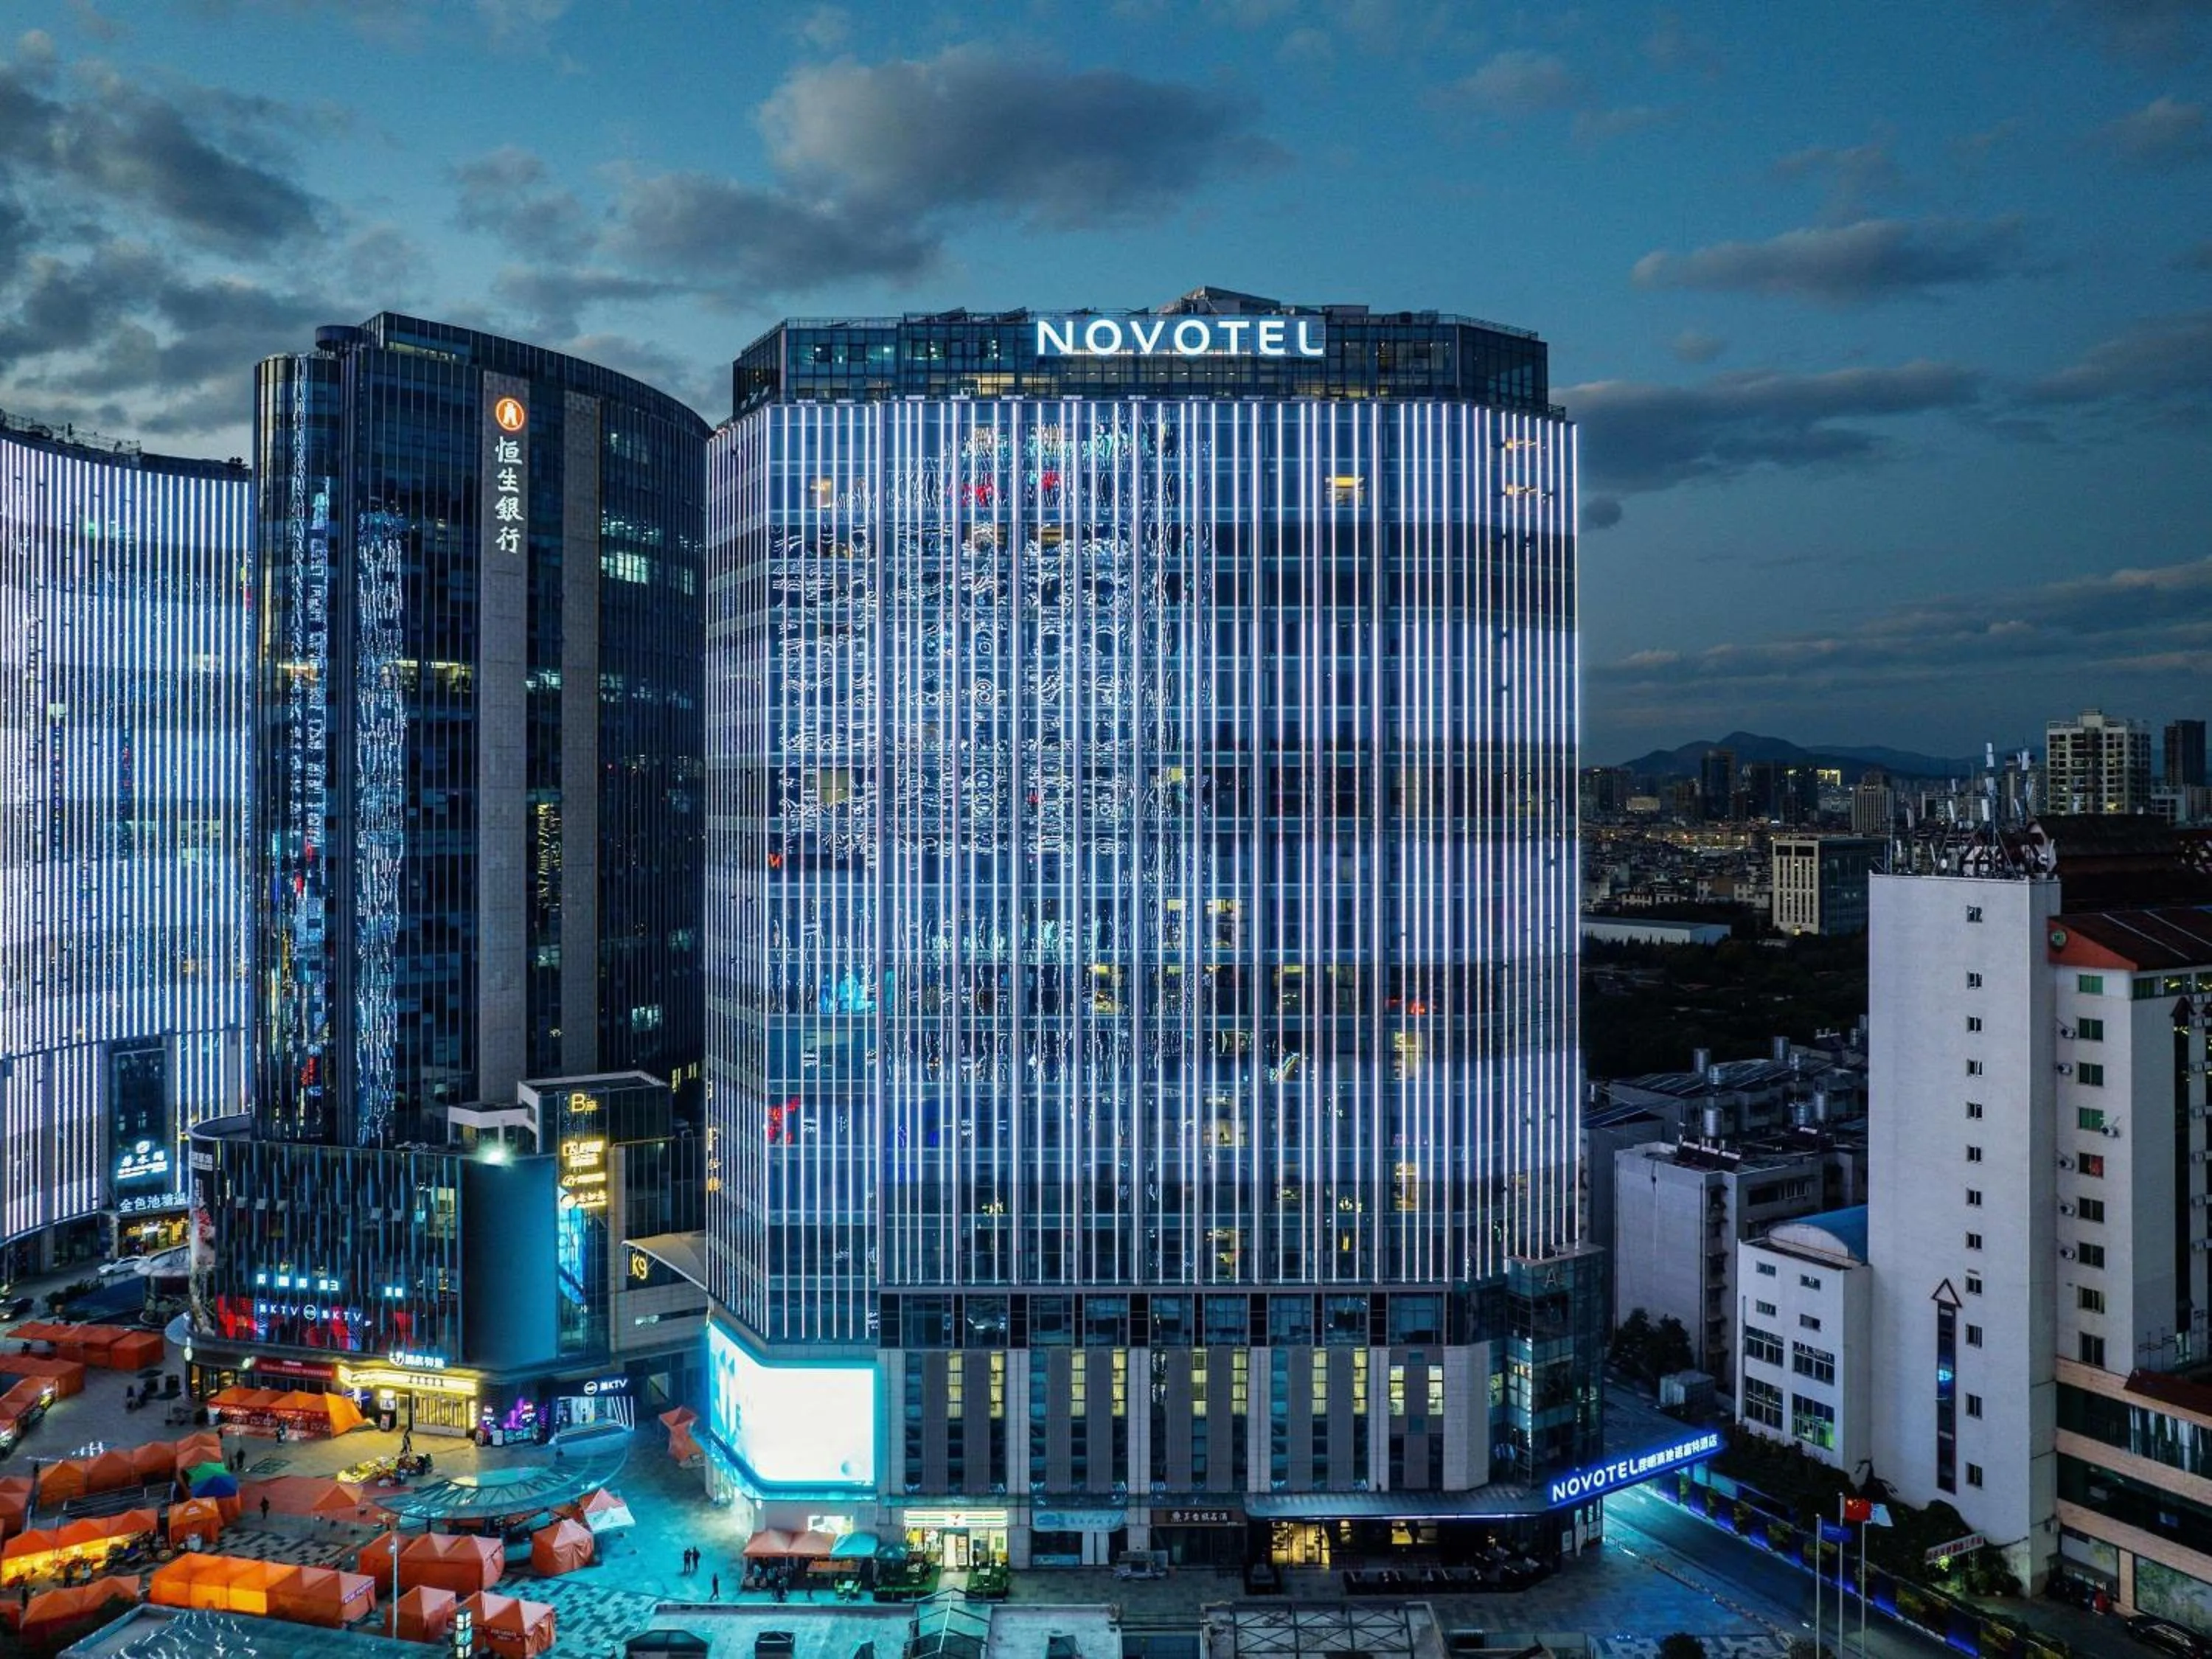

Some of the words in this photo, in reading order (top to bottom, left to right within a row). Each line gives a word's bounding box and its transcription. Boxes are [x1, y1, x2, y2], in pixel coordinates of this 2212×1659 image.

[1037, 319, 1324, 355] NOVOTEL
[495, 436, 524, 554] 恒生銀行
[119, 1192, 190, 1214] 金色池塘温
[632, 1253, 647, 1279] K9
[1552, 1459, 1638, 1502] NOVOTEL
